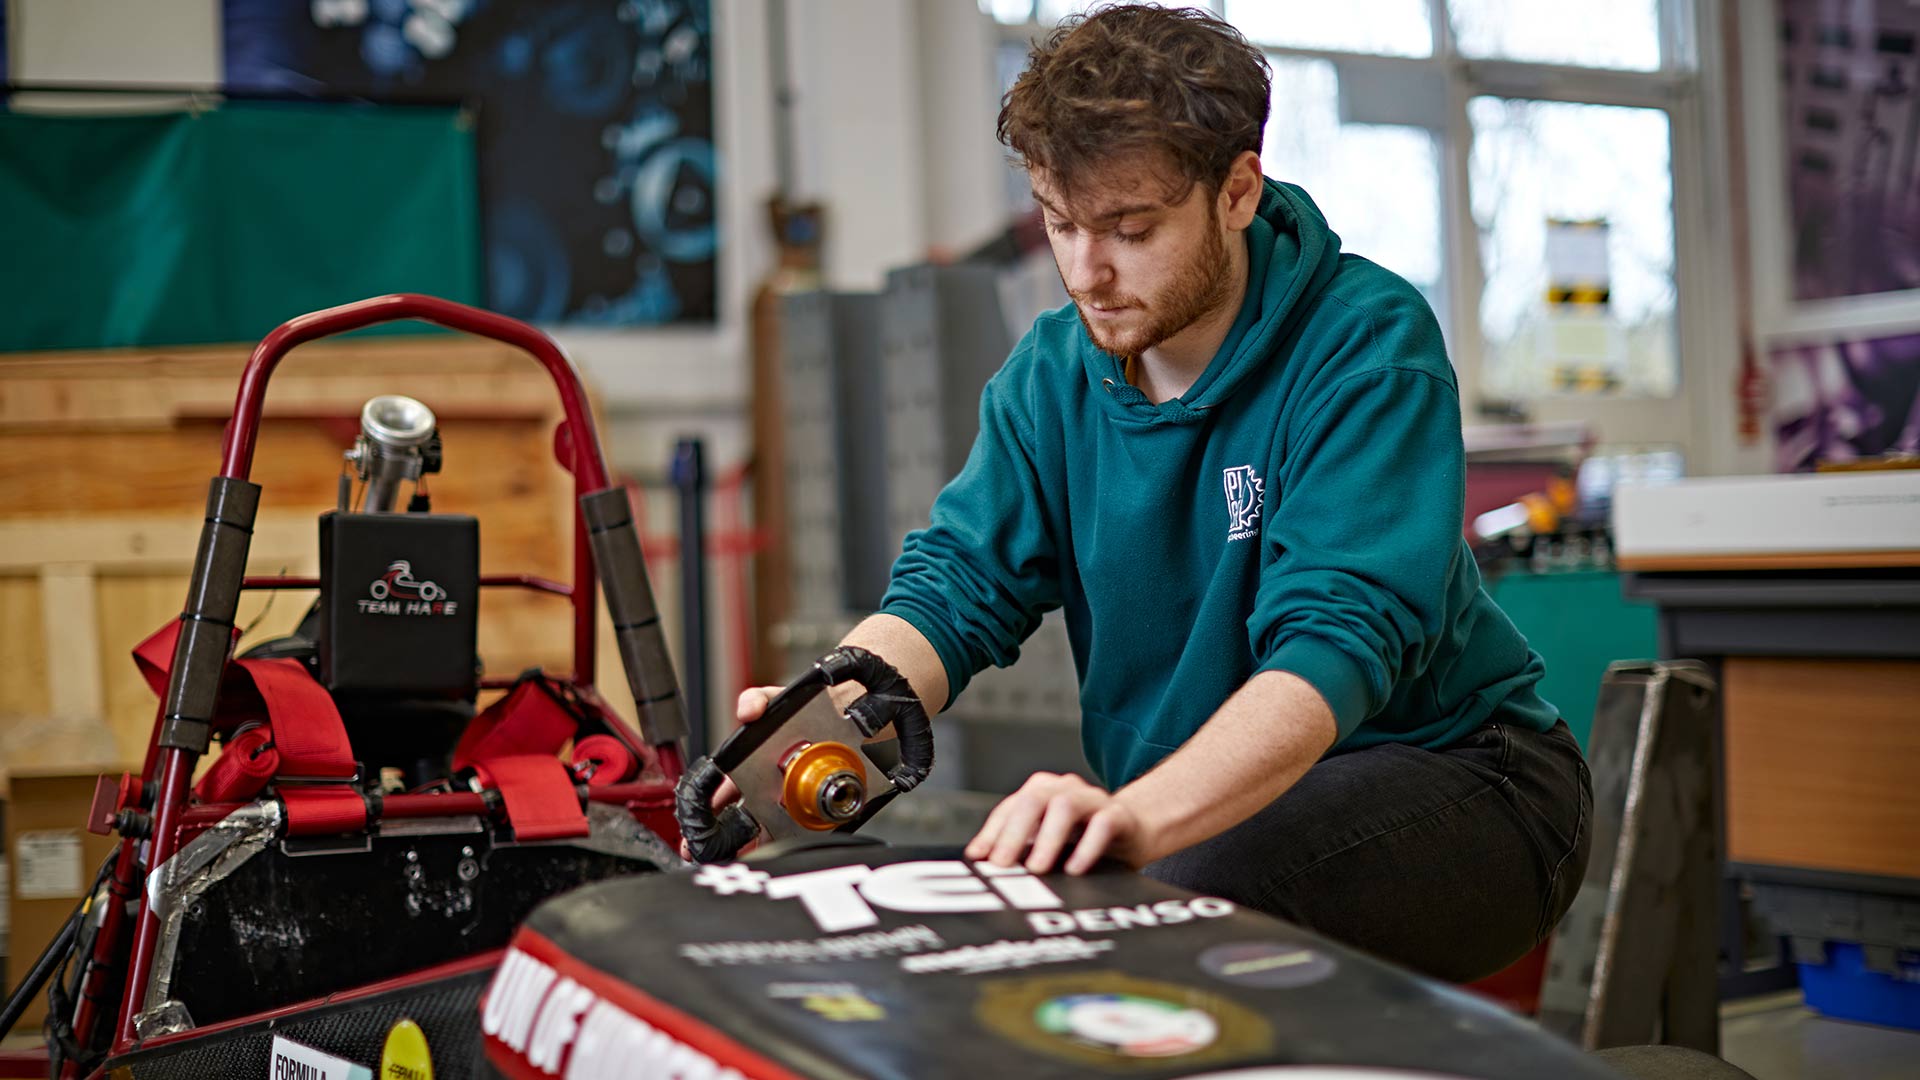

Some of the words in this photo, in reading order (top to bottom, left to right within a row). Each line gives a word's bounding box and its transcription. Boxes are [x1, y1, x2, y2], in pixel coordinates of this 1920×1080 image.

[358, 600, 400, 615] TEAM
[405, 601, 458, 615] HARE
[1026, 896, 1235, 935] DENSO
